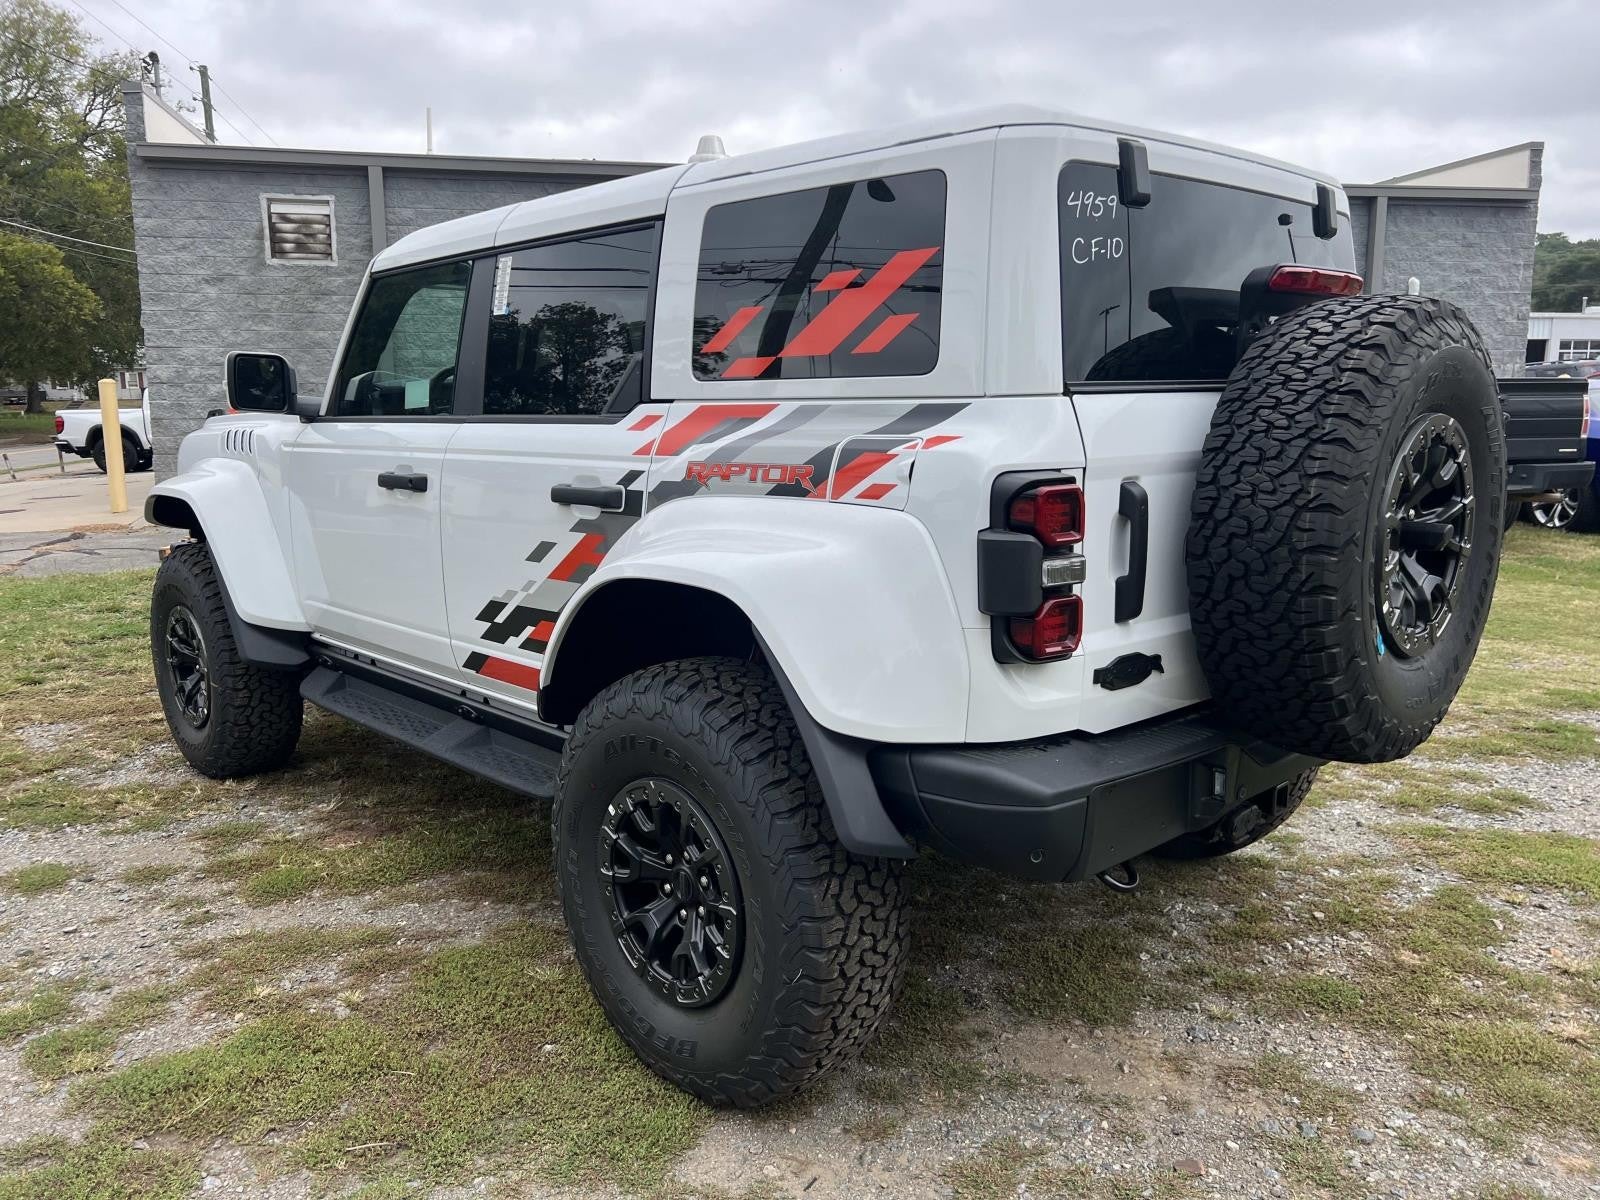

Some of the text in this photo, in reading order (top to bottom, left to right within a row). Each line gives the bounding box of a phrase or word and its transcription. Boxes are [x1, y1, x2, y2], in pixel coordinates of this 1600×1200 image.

[1067, 190, 1118, 219] 4959
[1072, 237, 1124, 264] CF-10
[685, 461, 818, 496] RAPTOR
